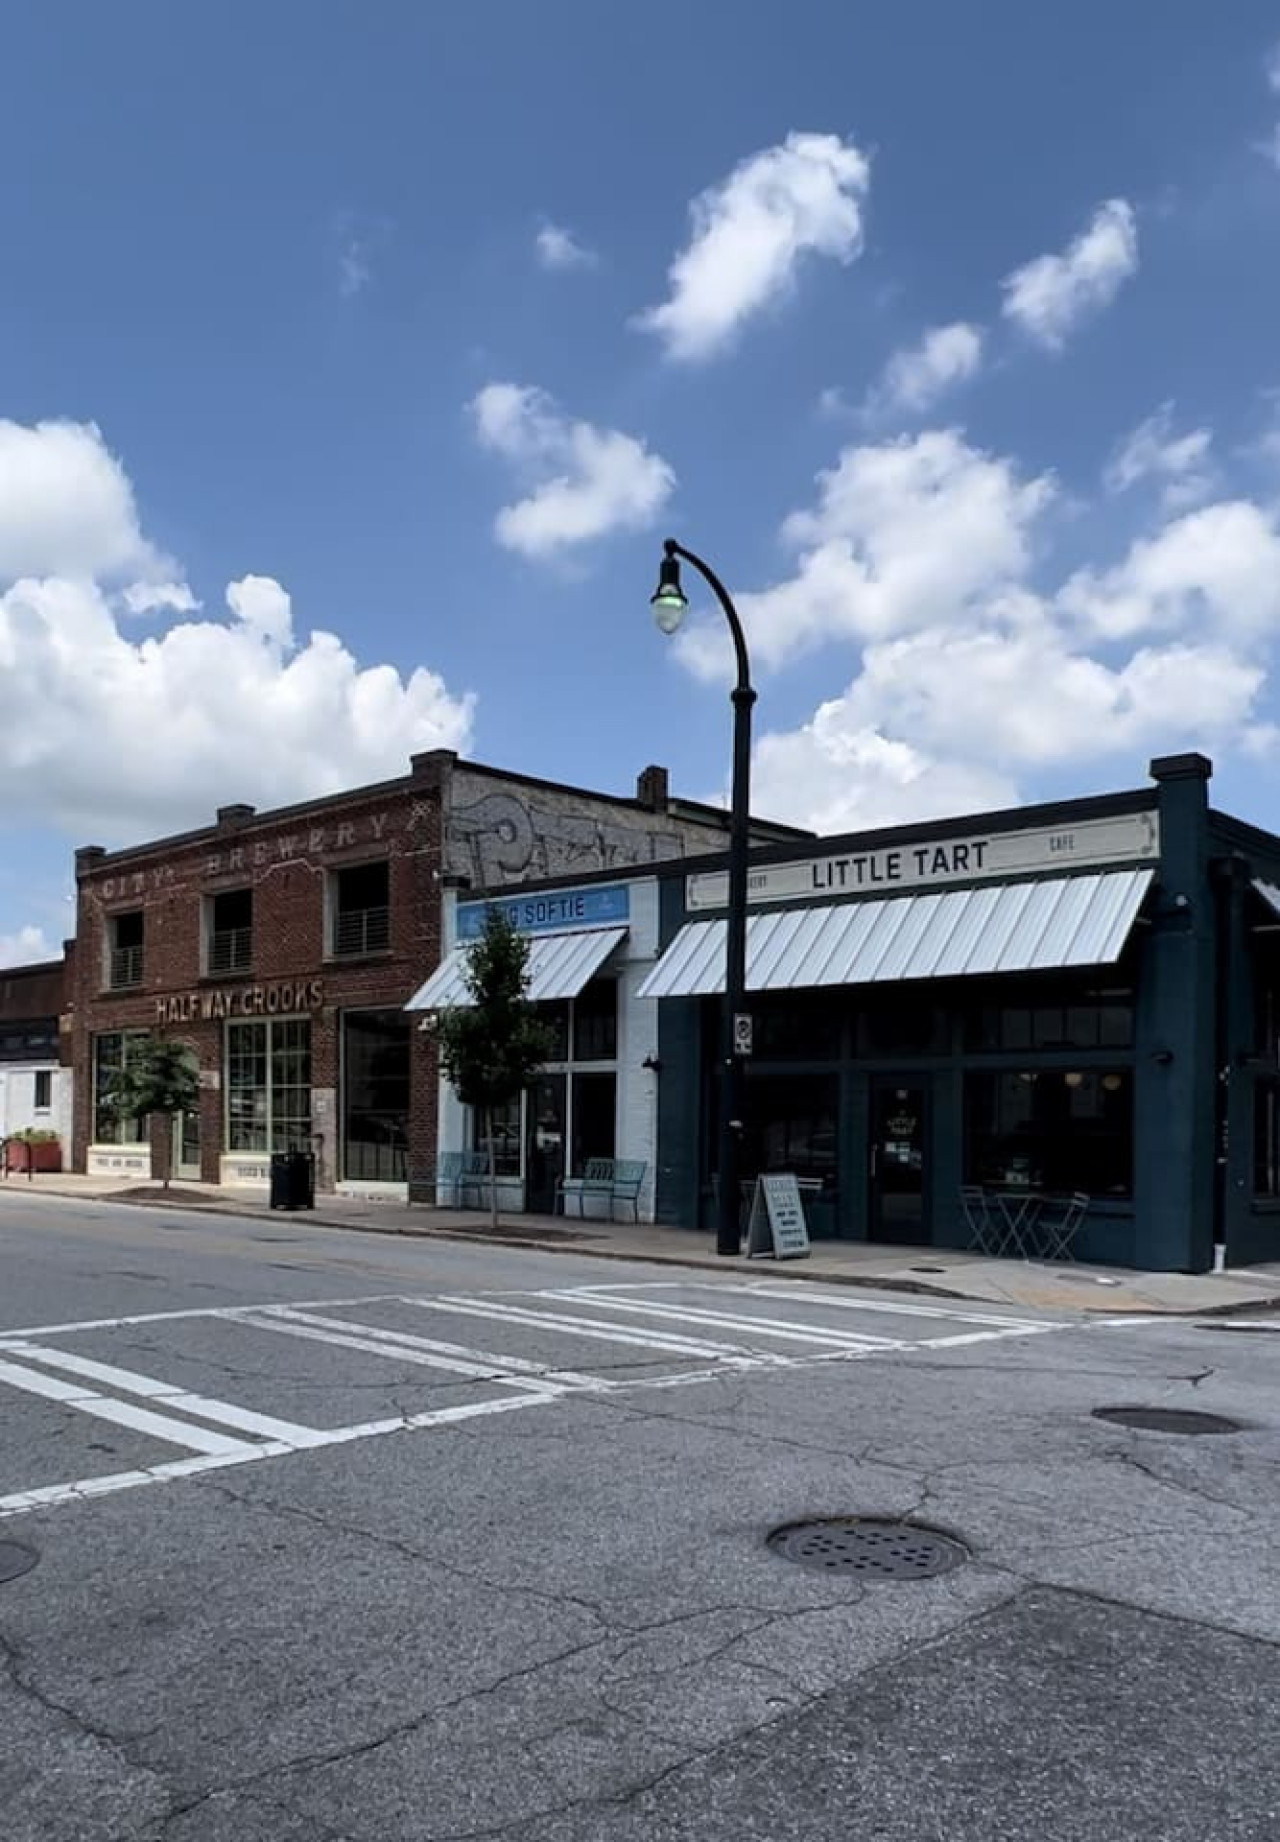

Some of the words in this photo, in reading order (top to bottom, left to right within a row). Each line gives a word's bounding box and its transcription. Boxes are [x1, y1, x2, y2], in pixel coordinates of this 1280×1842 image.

[206, 813, 387, 875] BREWERY
[1050, 834, 1074, 852] CAFE
[812, 852, 901, 888] LITTLE
[914, 841, 989, 876] TART
[525, 897, 585, 923] SOFTIE
[241, 980, 323, 1015] CROOKS
